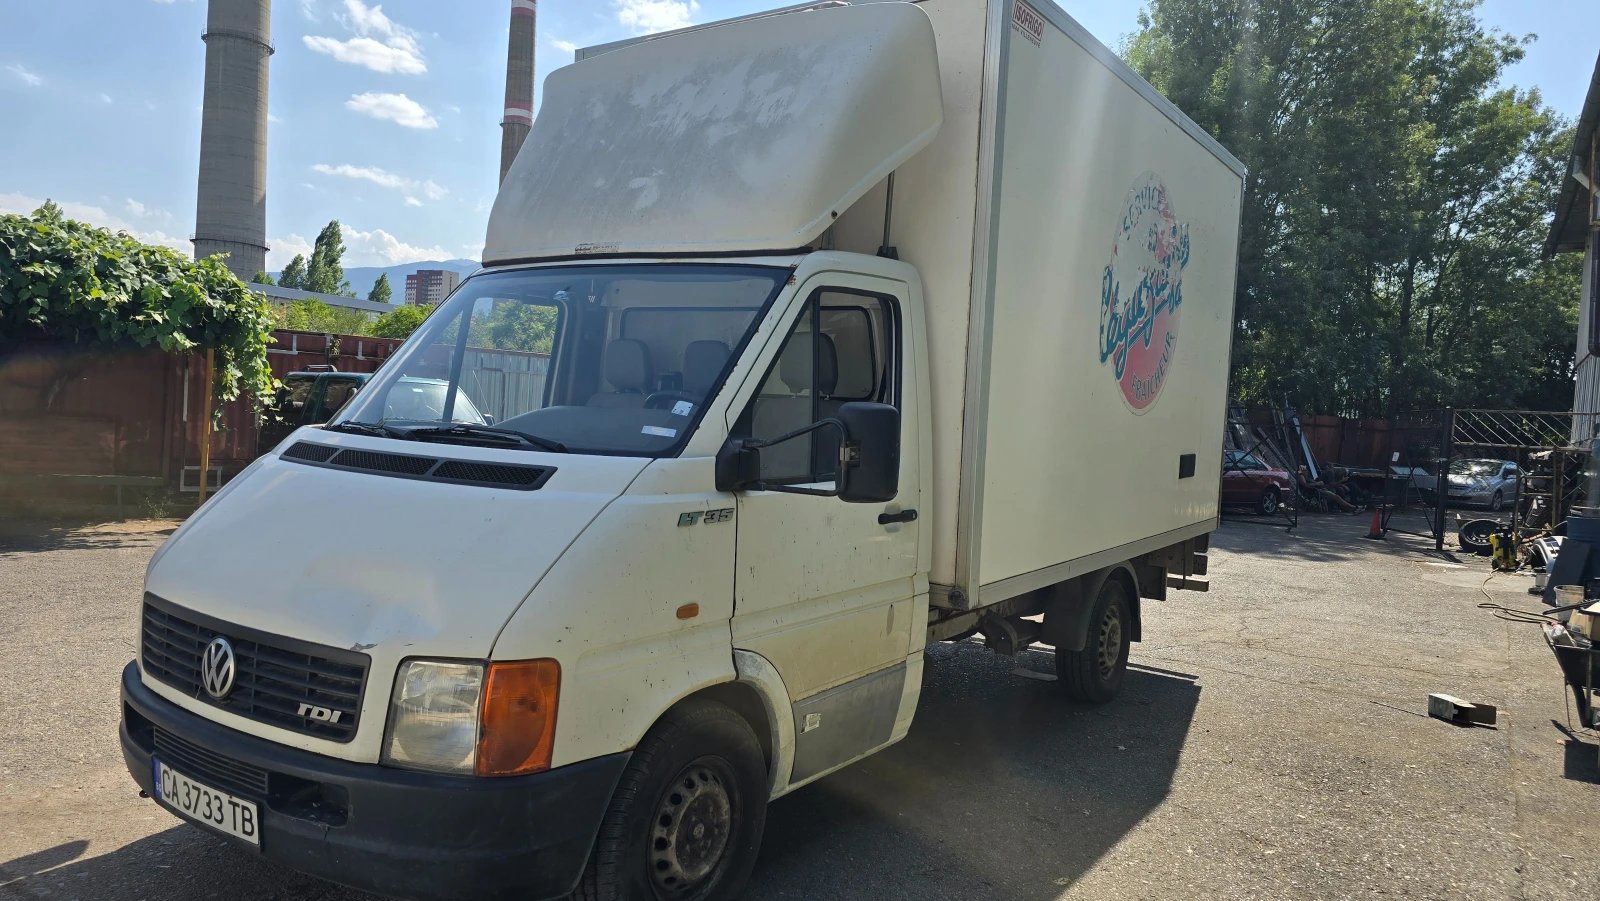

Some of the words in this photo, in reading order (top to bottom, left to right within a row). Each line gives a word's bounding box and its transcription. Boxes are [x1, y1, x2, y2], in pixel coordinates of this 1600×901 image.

[1014, 4, 1042, 37] ISOFRIGO
[677, 511, 704, 527] LT
[704, 508, 735, 524] 35
[297, 703, 342, 723] TDI
[162, 769, 180, 806] CA
[182, 781, 225, 825] 3733
[228, 799, 255, 837] TB
